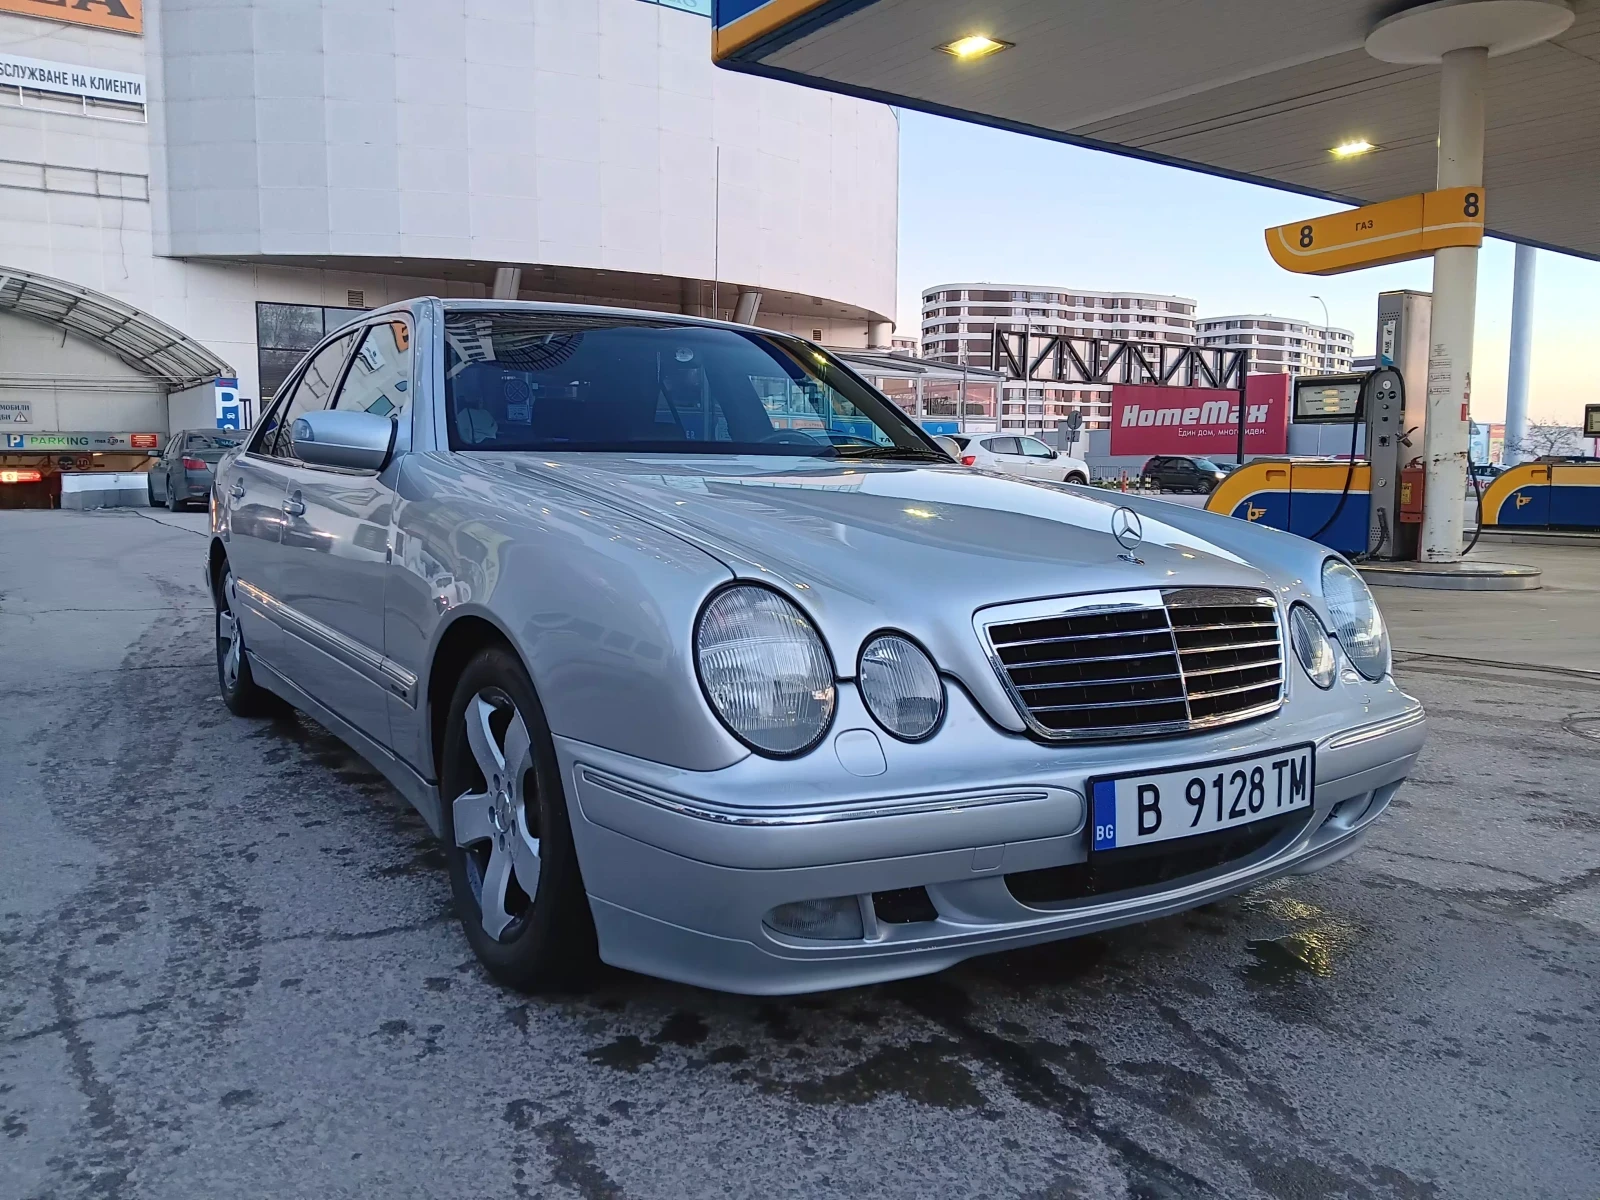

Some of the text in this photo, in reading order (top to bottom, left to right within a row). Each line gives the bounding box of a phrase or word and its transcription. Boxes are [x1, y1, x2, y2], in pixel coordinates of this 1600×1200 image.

[72, 73, 87, 88] НА
[90, 76, 141, 95] КЛИЕНТИ
[1463, 192, 1479, 217] 8
[1299, 225, 1314, 248] 8
[1355, 220, 1374, 231] ГАЗ
[215, 387, 238, 418] P
[1120, 401, 1269, 427] HomeMax
[31, 437, 89, 445] PARKING
[1178, 428, 1196, 437] Един
[1198, 428, 1216, 437] дом,
[1217, 428, 1239, 436] мног
[1137, 755, 1307, 836] B 9128 TM
[1096, 825, 1114, 841] BG
